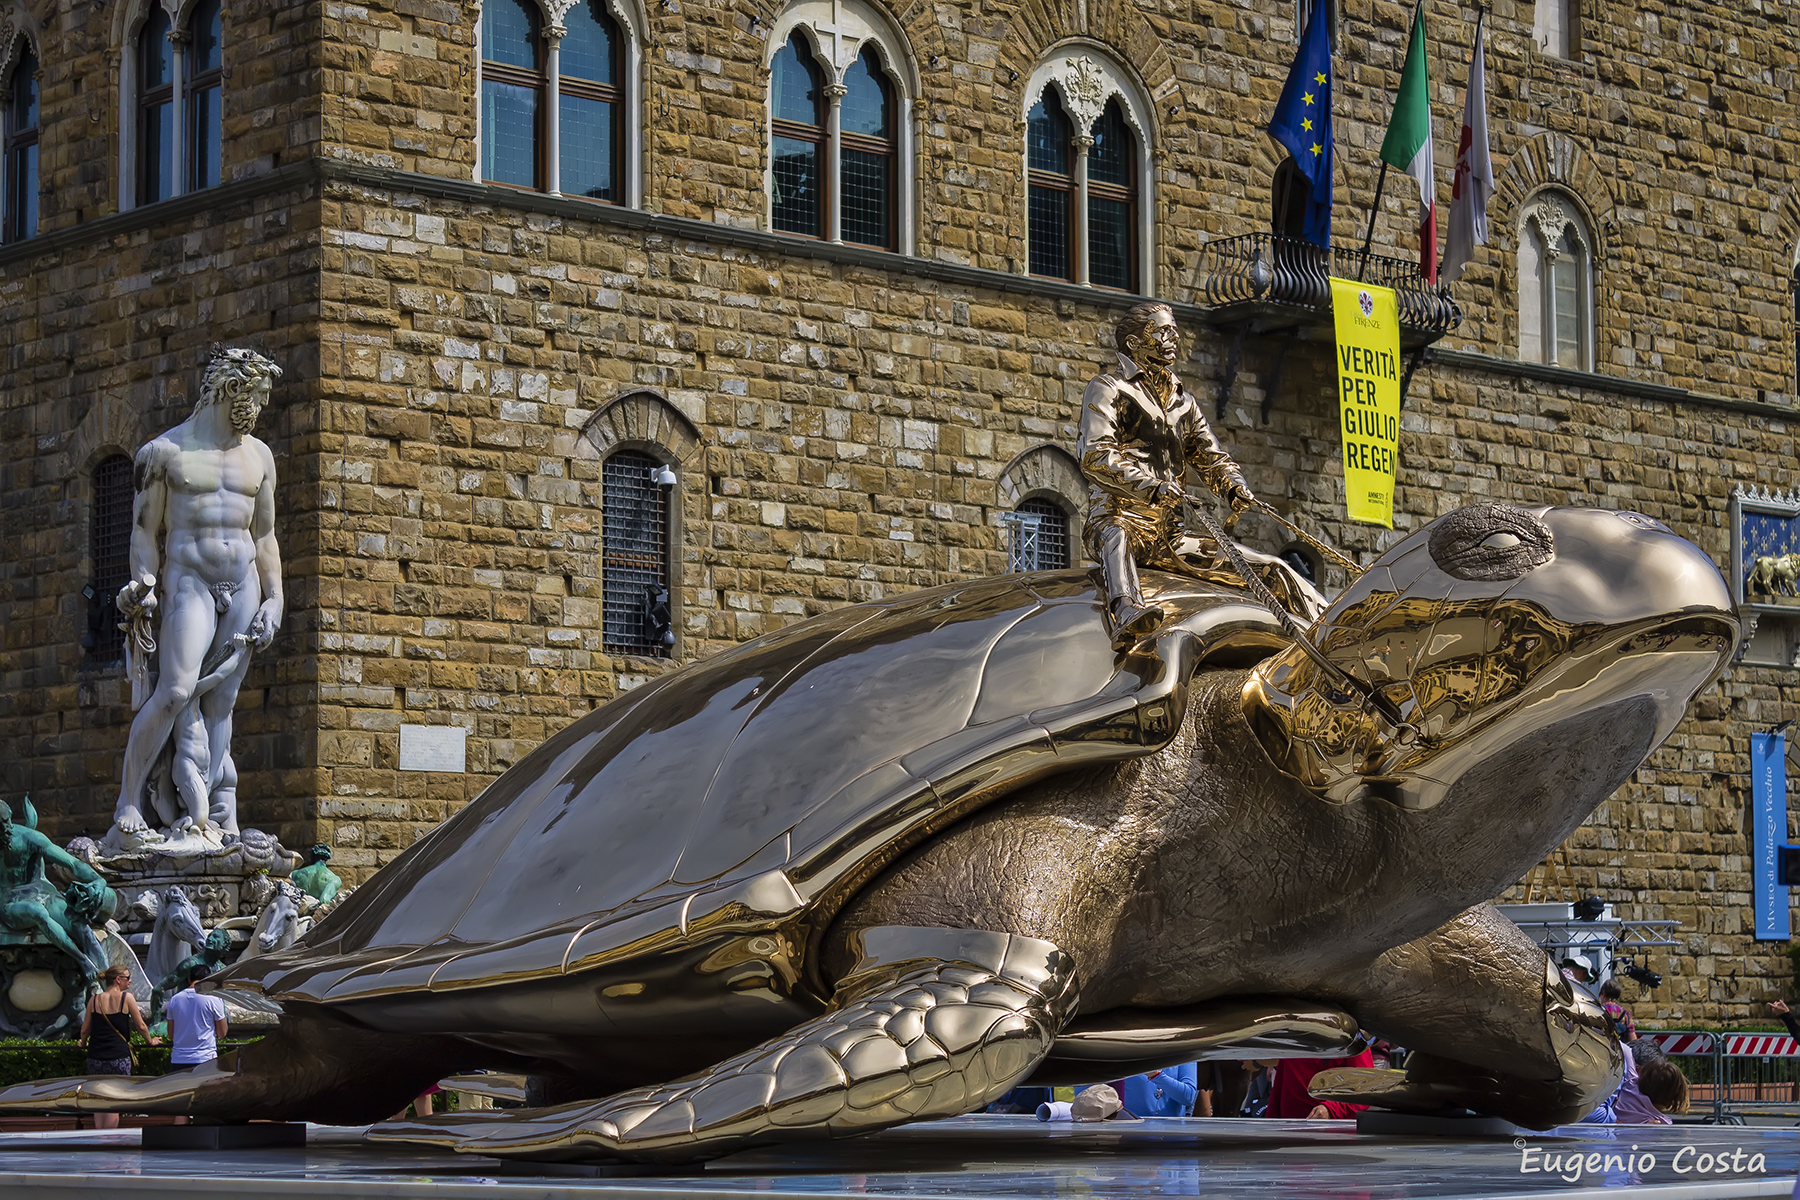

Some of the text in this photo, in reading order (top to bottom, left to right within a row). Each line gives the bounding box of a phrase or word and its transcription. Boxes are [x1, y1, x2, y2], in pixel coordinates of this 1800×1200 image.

[1354, 316, 1381, 329] FIRENZE
[1339, 344, 1397, 382] VERITÀ
[1342, 376, 1377, 407] PER
[1345, 407, 1396, 443] GIULIO
[1765, 766, 1773, 812] Vecchio
[1765, 815, 1777, 867] Palazzo
[1767, 870, 1775, 881] di
